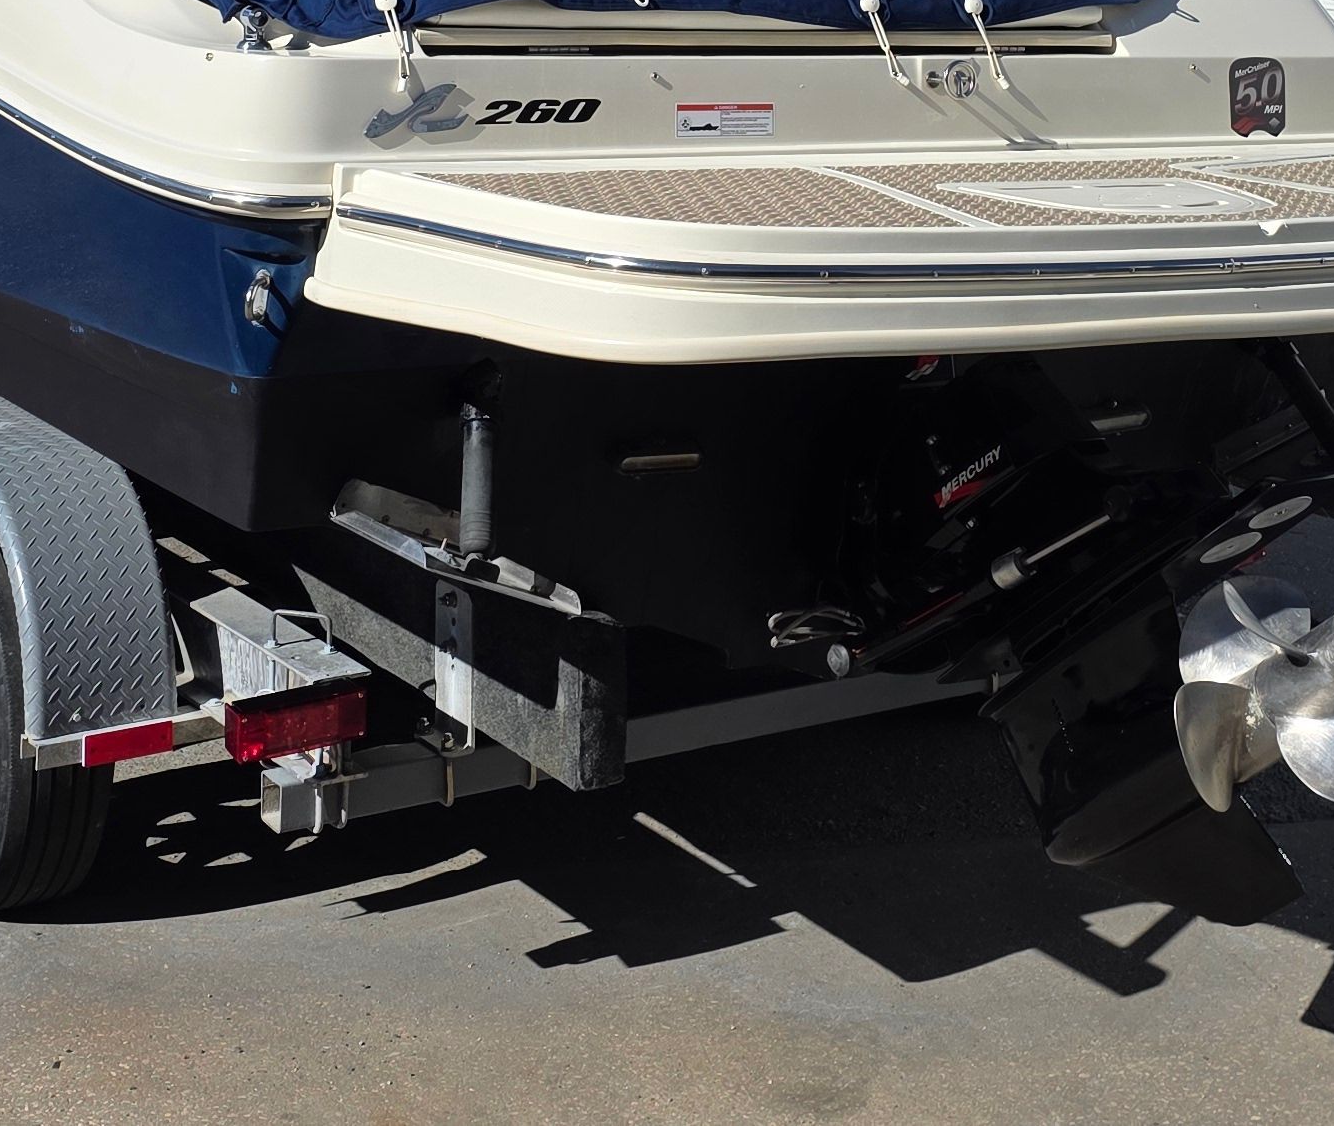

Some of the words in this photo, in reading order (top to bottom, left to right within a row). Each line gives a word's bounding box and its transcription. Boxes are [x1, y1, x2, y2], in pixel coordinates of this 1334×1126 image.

[1234, 60, 1271, 79] MerCruiser
[1234, 66, 1283, 115] 5.0
[474, 98, 602, 126] 260
[1263, 104, 1284, 114] MPI
[939, 445, 1001, 508] MERCURY
